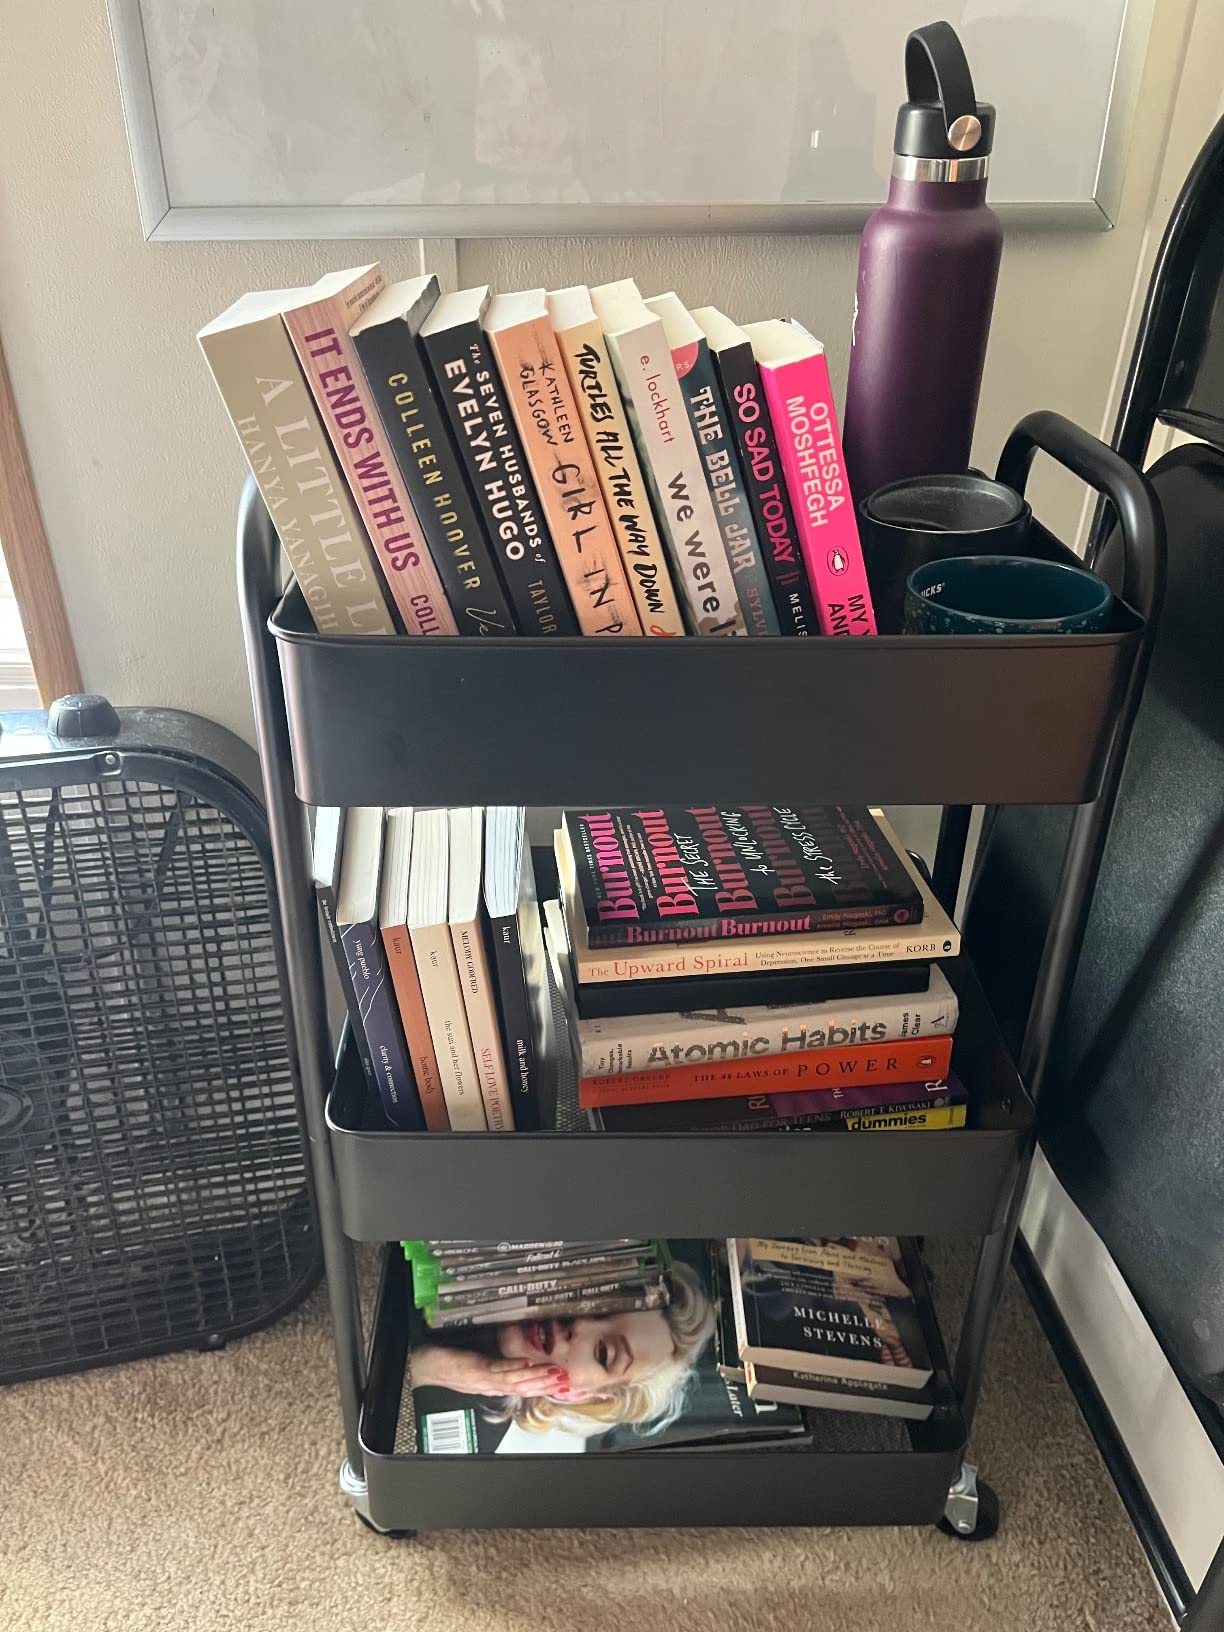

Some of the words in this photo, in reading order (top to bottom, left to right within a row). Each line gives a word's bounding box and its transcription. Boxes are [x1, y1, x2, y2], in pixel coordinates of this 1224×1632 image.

[305, 328, 343, 358] IT
[539, 362, 574, 444] KATHLEEN
[573, 343, 613, 425] TURTLES
[640, 354, 650, 372] e.
[647, 374, 675, 444] lockhart
[734, 383, 759, 423] SO
[319, 365, 374, 450] ENDS
[520, 366, 559, 446] GLASGOW
[690, 386, 723, 445] THE
[237, 416, 289, 509] HANYA
[444, 359, 497, 473] EVELYN
[484, 481, 525, 561] HUGO
[469, 343, 481, 365] The
[476, 371, 508, 438] SEVEN
[499, 446, 541, 548] HUSBANDS
[533, 552, 546, 563] of
[595, 430, 624, 468] ALL
[744, 427, 774, 482] SAD
[786, 396, 828, 528] MOSHFEGH
[810, 402, 845, 511] OTTESSA
[255, 376, 294, 406] A
[275, 416, 367, 588] LITTLE
[354, 452, 404, 530] WITH
[388, 373, 443, 486] COLLEEN
[433, 493, 481, 590] HOOVER
[608, 469, 635, 510] THE
[705, 452, 735, 517] BELL
[552, 462, 597, 554] GIRL
[584, 569, 615, 609] IN
[619, 515, 650, 557] WAY
[760, 488, 795, 564] TODAY
[384, 533, 421, 572] US
[728, 521, 754, 574] JAR
[633, 563, 667, 613] DOWN
[684, 529, 721, 614] were
[527, 579, 557, 634] TAYLOR
[848, 594, 869, 623] MY
[577, 812, 640, 920] Burnout
[630, 809, 699, 917] Burnout
[673, 832, 709, 867] SECRET
[683, 806, 758, 912] Burnout
[738, 805, 817, 908] Burnout
[792, 831, 833, 863] STRESS
[392, 937, 402, 955] kaur
[502, 926, 511, 943] kaur
[626, 924, 717, 944] Burnout
[721, 915, 811, 937] Burnout
[906, 944, 937, 953] KORB
[353, 939, 364, 961] yung
[359, 957, 370, 980] pueblo
[429, 950, 439, 968] kaur
[461, 930, 472, 960] MELODY
[467, 961, 478, 994] GODFRED
[589, 967, 608, 977] The
[614, 957, 686, 978] Upward
[693, 953, 749, 973] Spiral
[755, 951, 774, 960] Using
[776, 947, 820, 958] Neuroscience
[829, 945, 855, 953] Reverse
[856, 944, 867, 952] the
[868, 943, 891, 951] Course
[800, 956, 815, 964] One
[816, 952, 835, 962] Small
[648, 1031, 770, 1065] Atomic
[781, 1020, 887, 1050] Habits
[912, 1013, 921, 1035] Clear
[420, 1056, 429, 1077] home
[444, 1020, 453, 1032] the
[449, 1045, 459, 1058] and
[455, 1071, 464, 1096] flowers
[481, 1048, 494, 1070] SELF
[517, 1040, 527, 1056] milk
[519, 1057, 529, 1071] and
[387, 1072, 398, 1104] connection
[424, 1077, 435, 1095] body
[485, 1072, 499, 1098] LOVE
[521, 1071, 530, 1093] honey
[694, 1073, 716, 1083] THE
[721, 1072, 732, 1080] 48
[737, 1069, 769, 1079] LAWS
[773, 1068, 790, 1076] OF
[797, 1057, 898, 1078] POWER
[840, 1107, 876, 1119] ROBERT
[888, 1102, 931, 1113] KIYOSAKI
[852, 1113, 927, 1130] dummies
[498, 1284, 523, 1296] CALL
[527, 1279, 557, 1292] DUTY
[794, 1306, 885, 1330] MICHELLE
[803, 1327, 883, 1348] STEVENS
[793, 1371, 838, 1385] Katherine
[841, 1376, 888, 1391] Applegate
[726, 1386, 743, 1418] Later
